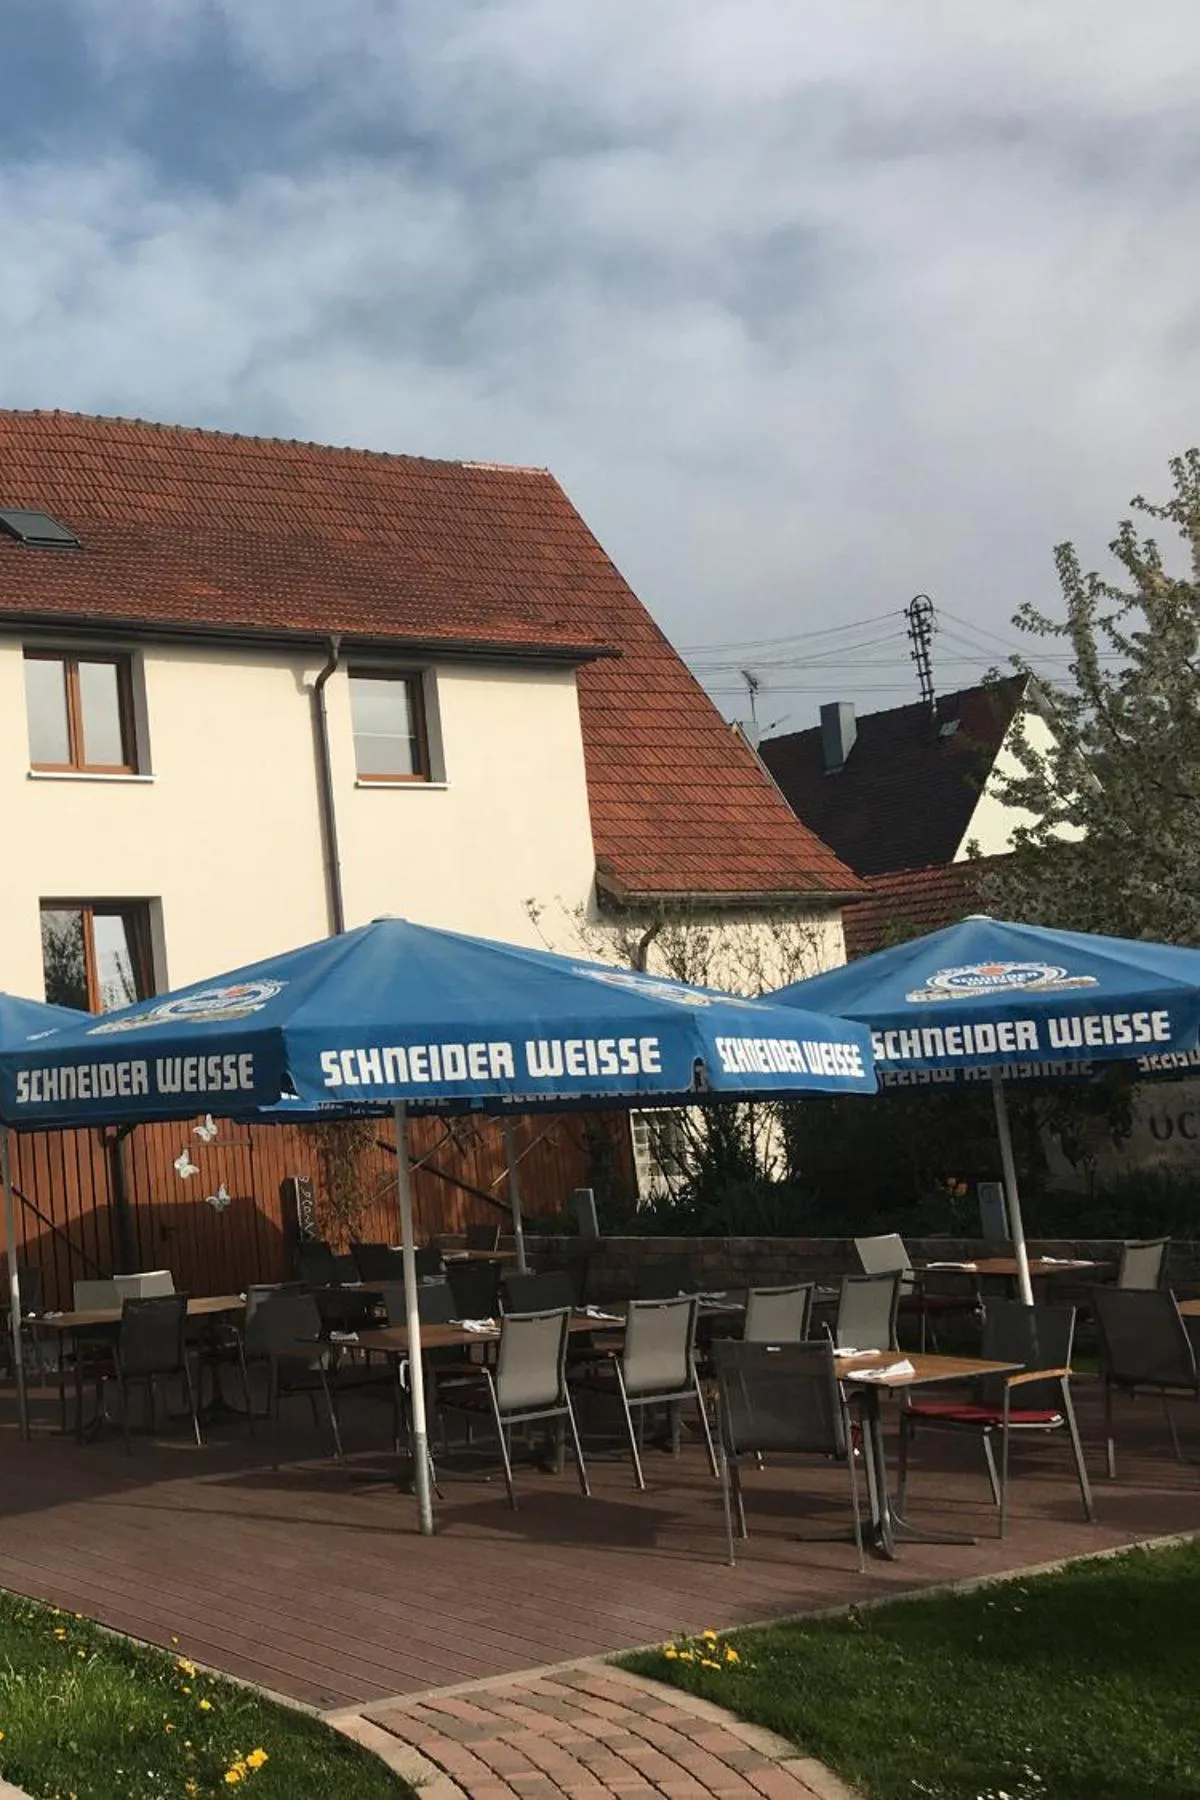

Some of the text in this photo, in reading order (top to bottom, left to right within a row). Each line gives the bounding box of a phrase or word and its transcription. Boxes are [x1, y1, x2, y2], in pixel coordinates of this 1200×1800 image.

[715, 1037, 866, 1077] SCHNEIDER WEISSE
[870, 1010, 1171, 1060] SCHNEIDER WEISSE
[16, 1054, 254, 1104] SCHNEIDER WEISSE
[320, 1038, 662, 1087] SCHNEIDER WEISSE
